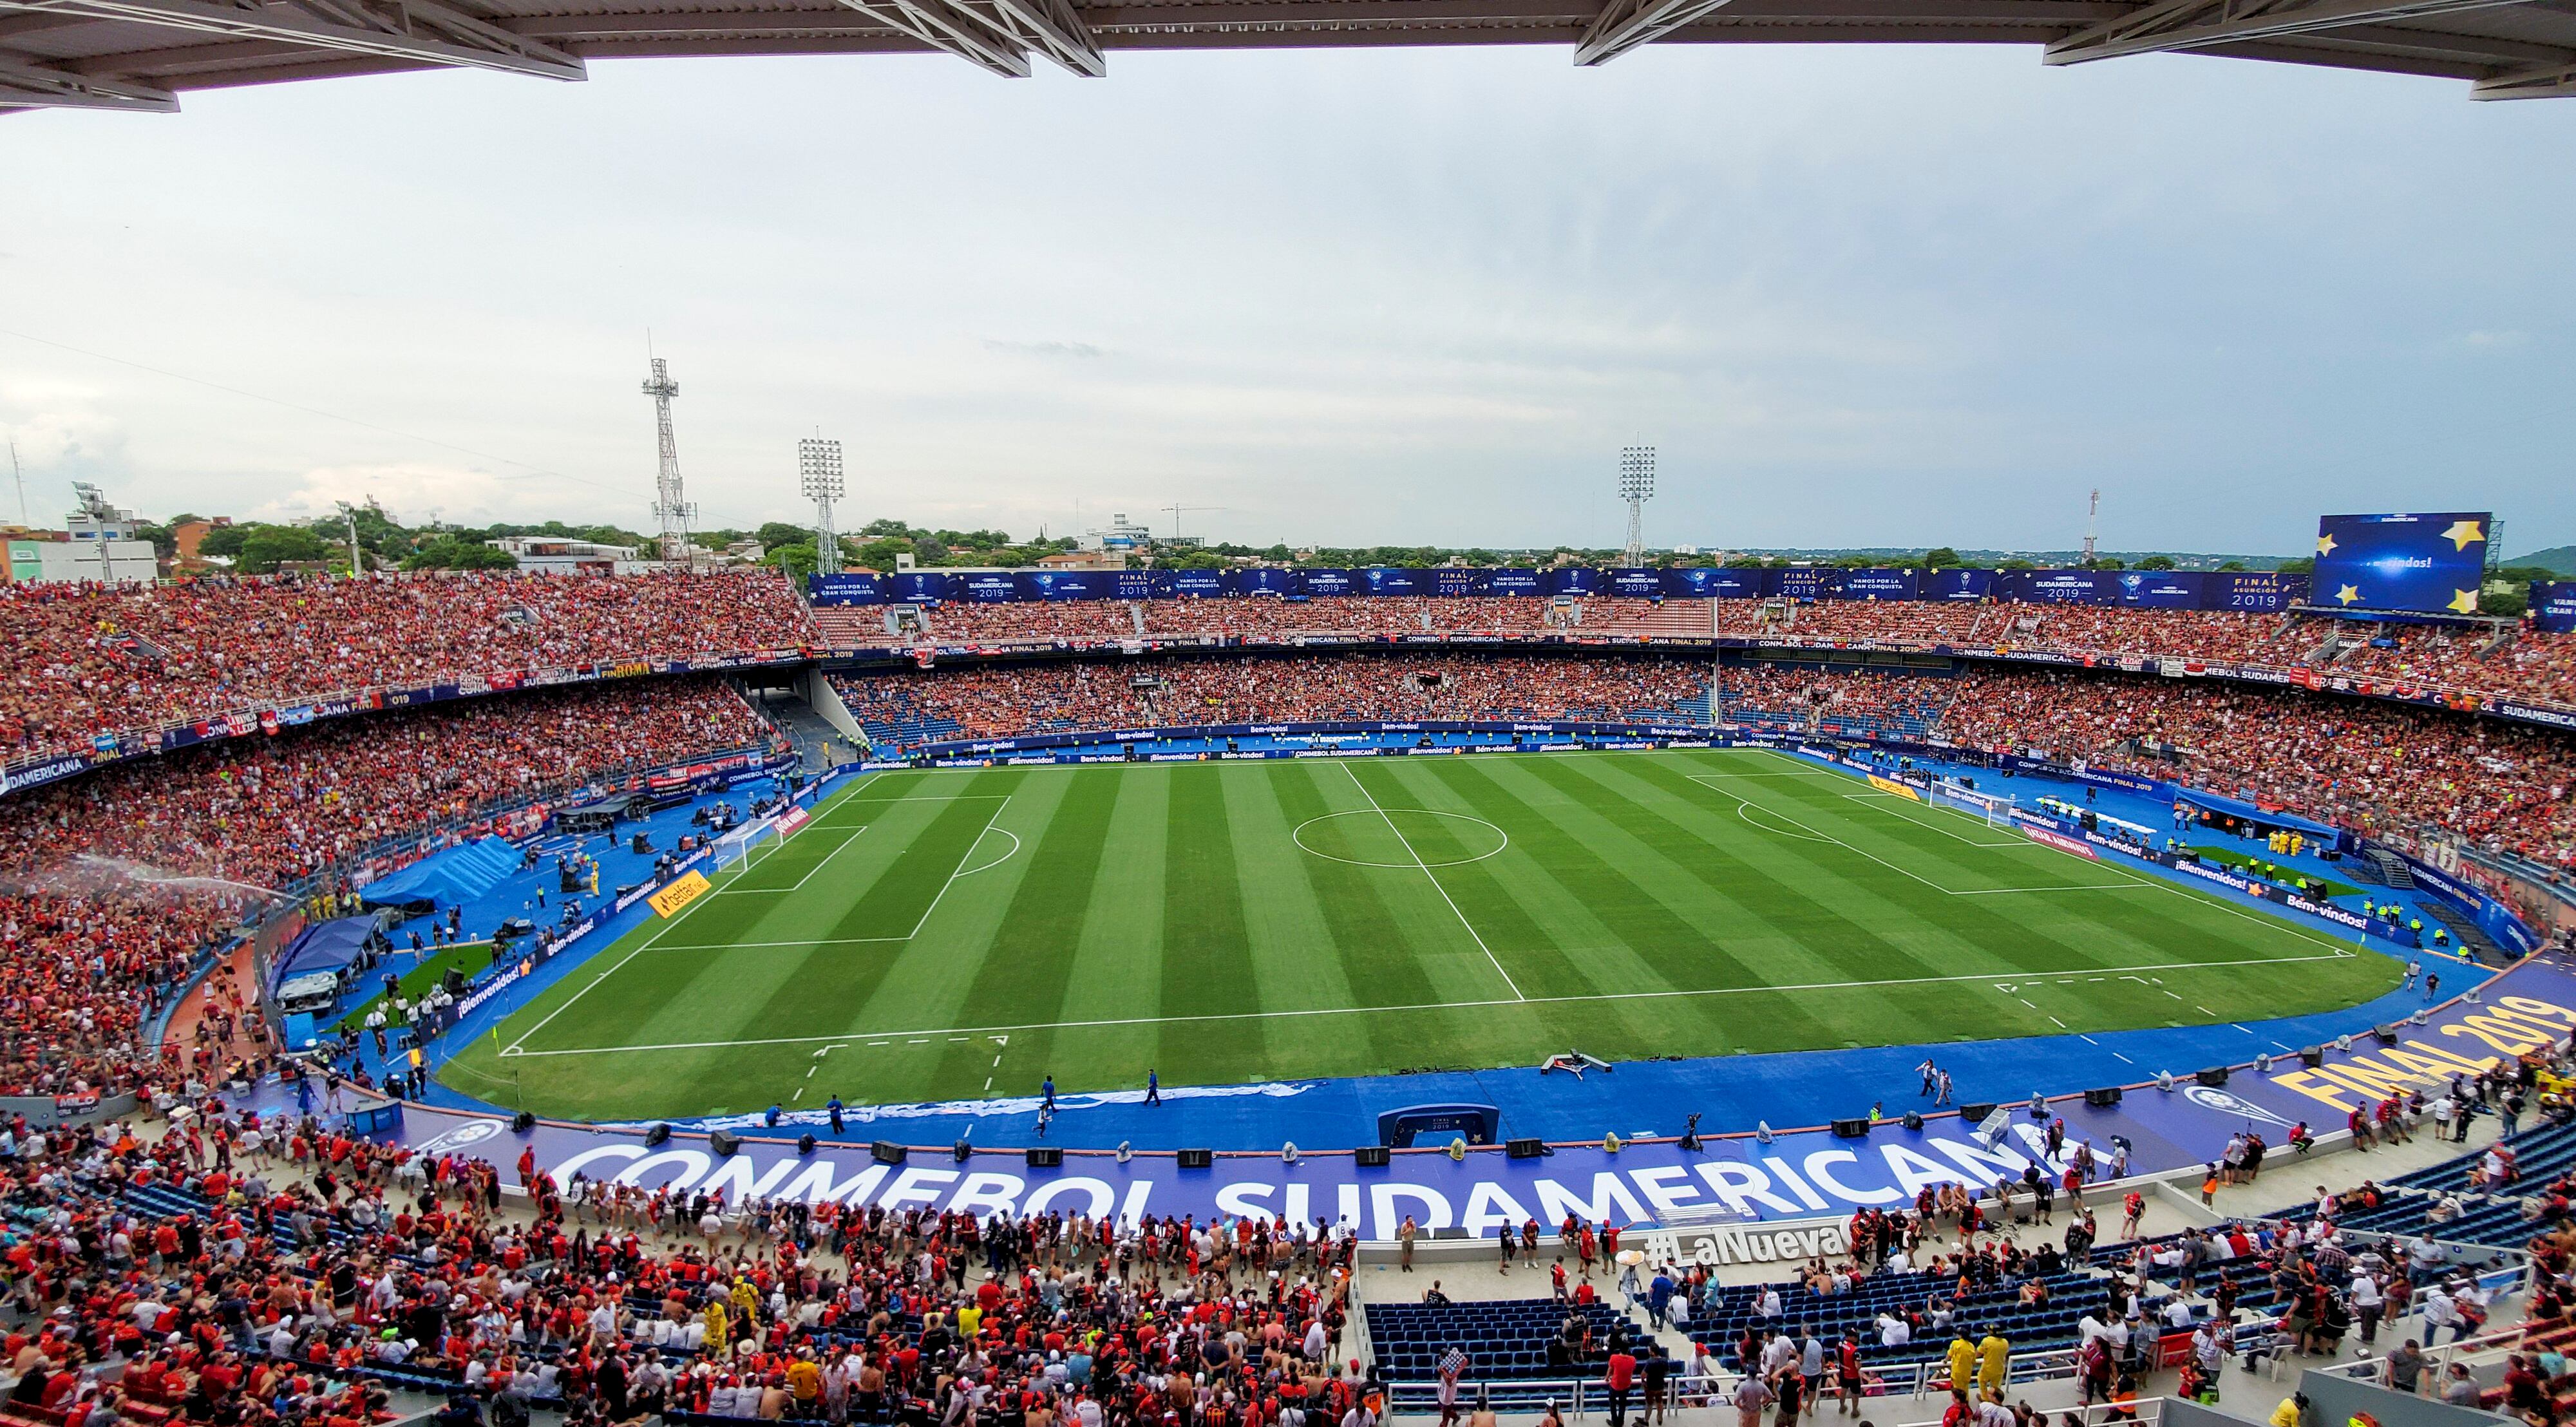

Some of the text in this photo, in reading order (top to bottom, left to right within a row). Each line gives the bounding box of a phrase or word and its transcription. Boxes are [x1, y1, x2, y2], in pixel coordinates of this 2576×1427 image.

[2235, 578, 2278, 587] FINAL
[2048, 589, 2078, 598] 2019
[2231, 595, 2276, 606] 2019
[973, 741, 1014, 750] Bem-vindos!
[1475, 744, 1517, 753] Bem-vindos!
[1540, 743, 1583, 752] ¡Bienvenidos!
[1667, 741, 1710, 749] ¡Bienvenidos!
[1732, 740, 1774, 748] Bem-vindos!
[1408, 747, 1452, 756] ¡Bienvenidos!
[1797, 746, 1828, 760] ¡Bienvenidos!
[936, 759, 982, 767] Bem-vindos!
[1008, 757, 1056, 765] ¡Bienvenidos!
[1080, 755, 1125, 763] Bem-vindos!
[1150, 753, 1197, 762] ¡Bienvenidos!
[860, 761, 911, 770] ¡Bienvenidos!
[1842, 757, 1872, 772] Bem-vindos!
[729, 771, 763, 782] CONMEBOL
[1889, 771, 1926, 789] ¡Bienenidos!
[2114, 779, 2136, 788] FINAL
[2136, 782, 2153, 791] 2019
[1946, 788, 1984, 807] Bem-vindos!
[2009, 807, 2058, 830] ¡Bienvenidos!
[2023, 826, 2094, 857] QATAR AIRWAYS
[2085, 831, 2142, 857] Bem-vindos!
[674, 848, 706, 874] Bem-vindos!
[2175, 859, 2247, 890] ¡Bienvenidos!
[616, 879, 657, 913] ¡Bienvenidos!
[668, 880, 696, 906] betfair
[2287, 894, 2368, 930] Bem-vindos!
[547, 918, 594, 956] Bem-vindos!
[458, 965, 520, 1019] ¡Bienvenidos!
[1216, 1122, 2115, 1241] SUDAMERICANA
[2271, 1039, 2499, 1115] FINAL
[2438, 996, 2576, 1057] 2019
[1340, 1225, 1346, 1234] 8
[1843, 1282, 1849, 1291] 3
